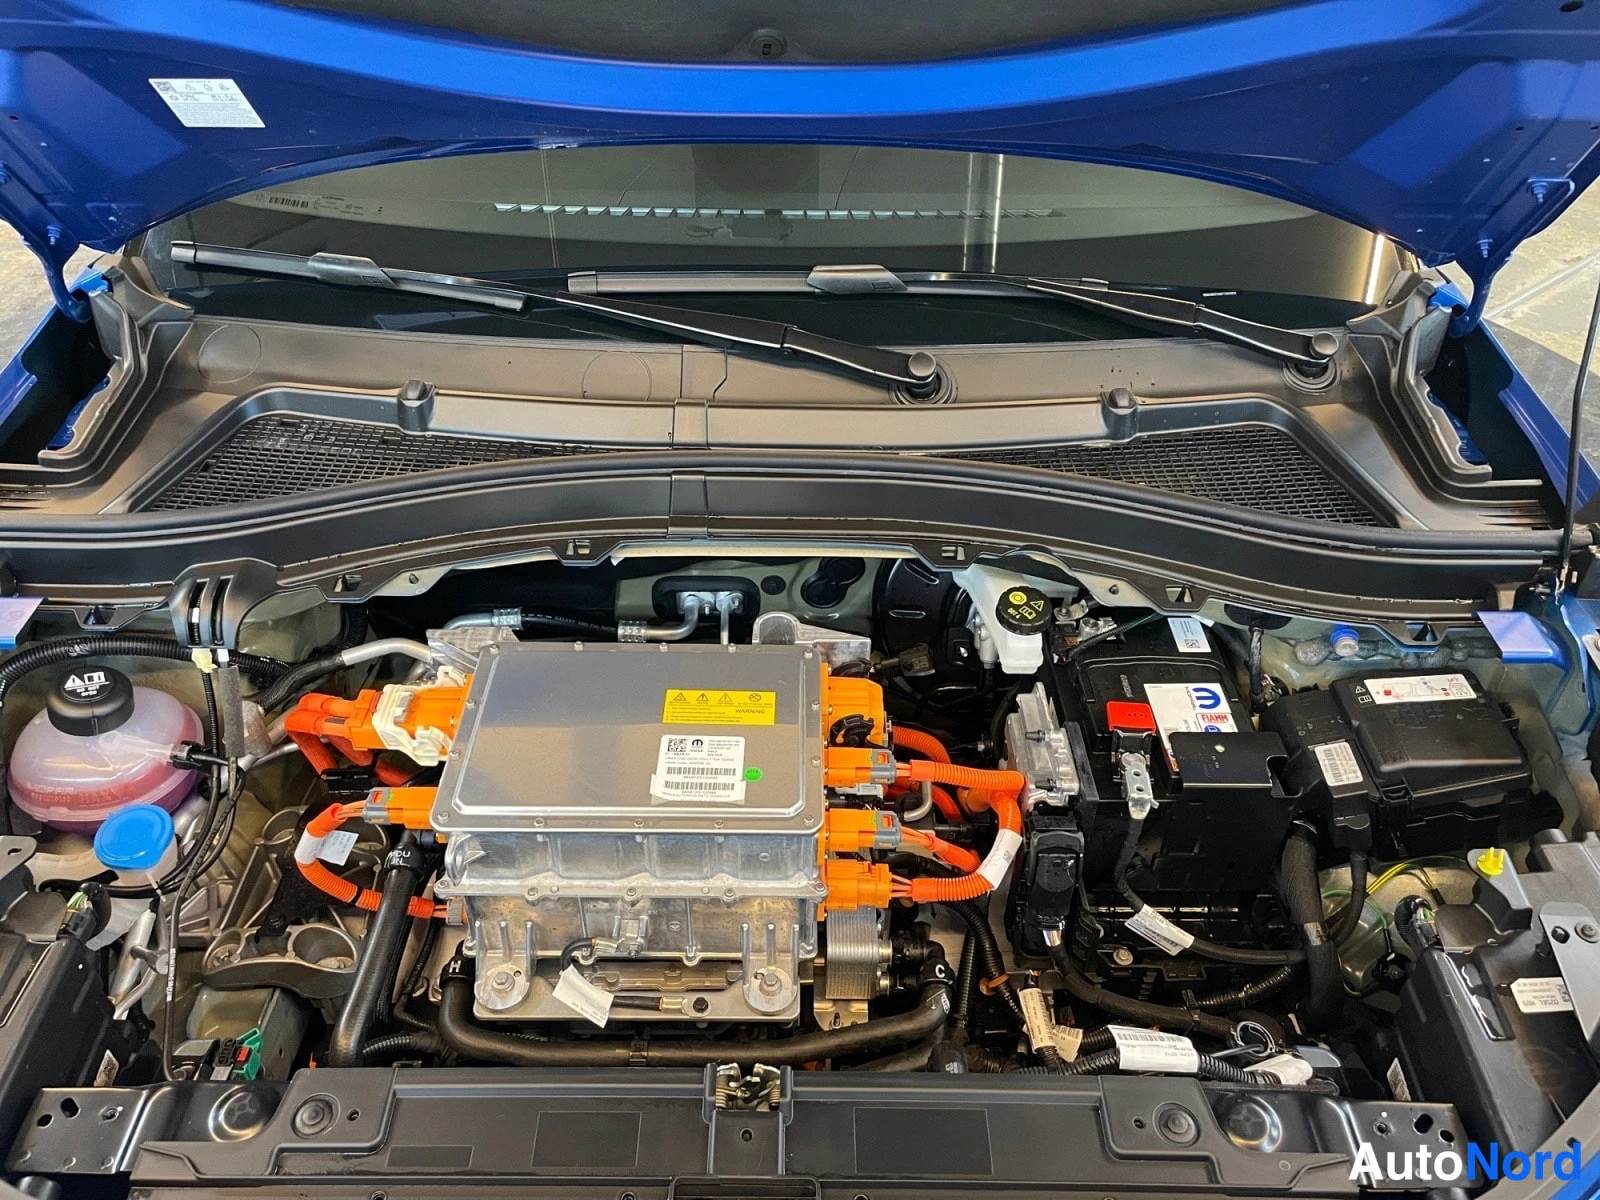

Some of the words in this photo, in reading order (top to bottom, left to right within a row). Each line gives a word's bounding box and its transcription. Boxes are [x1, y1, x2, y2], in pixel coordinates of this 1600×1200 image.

[1201, 714, 1229, 722] FIAMM
[449, 960, 461, 973] H
[935, 964, 945, 978] C
